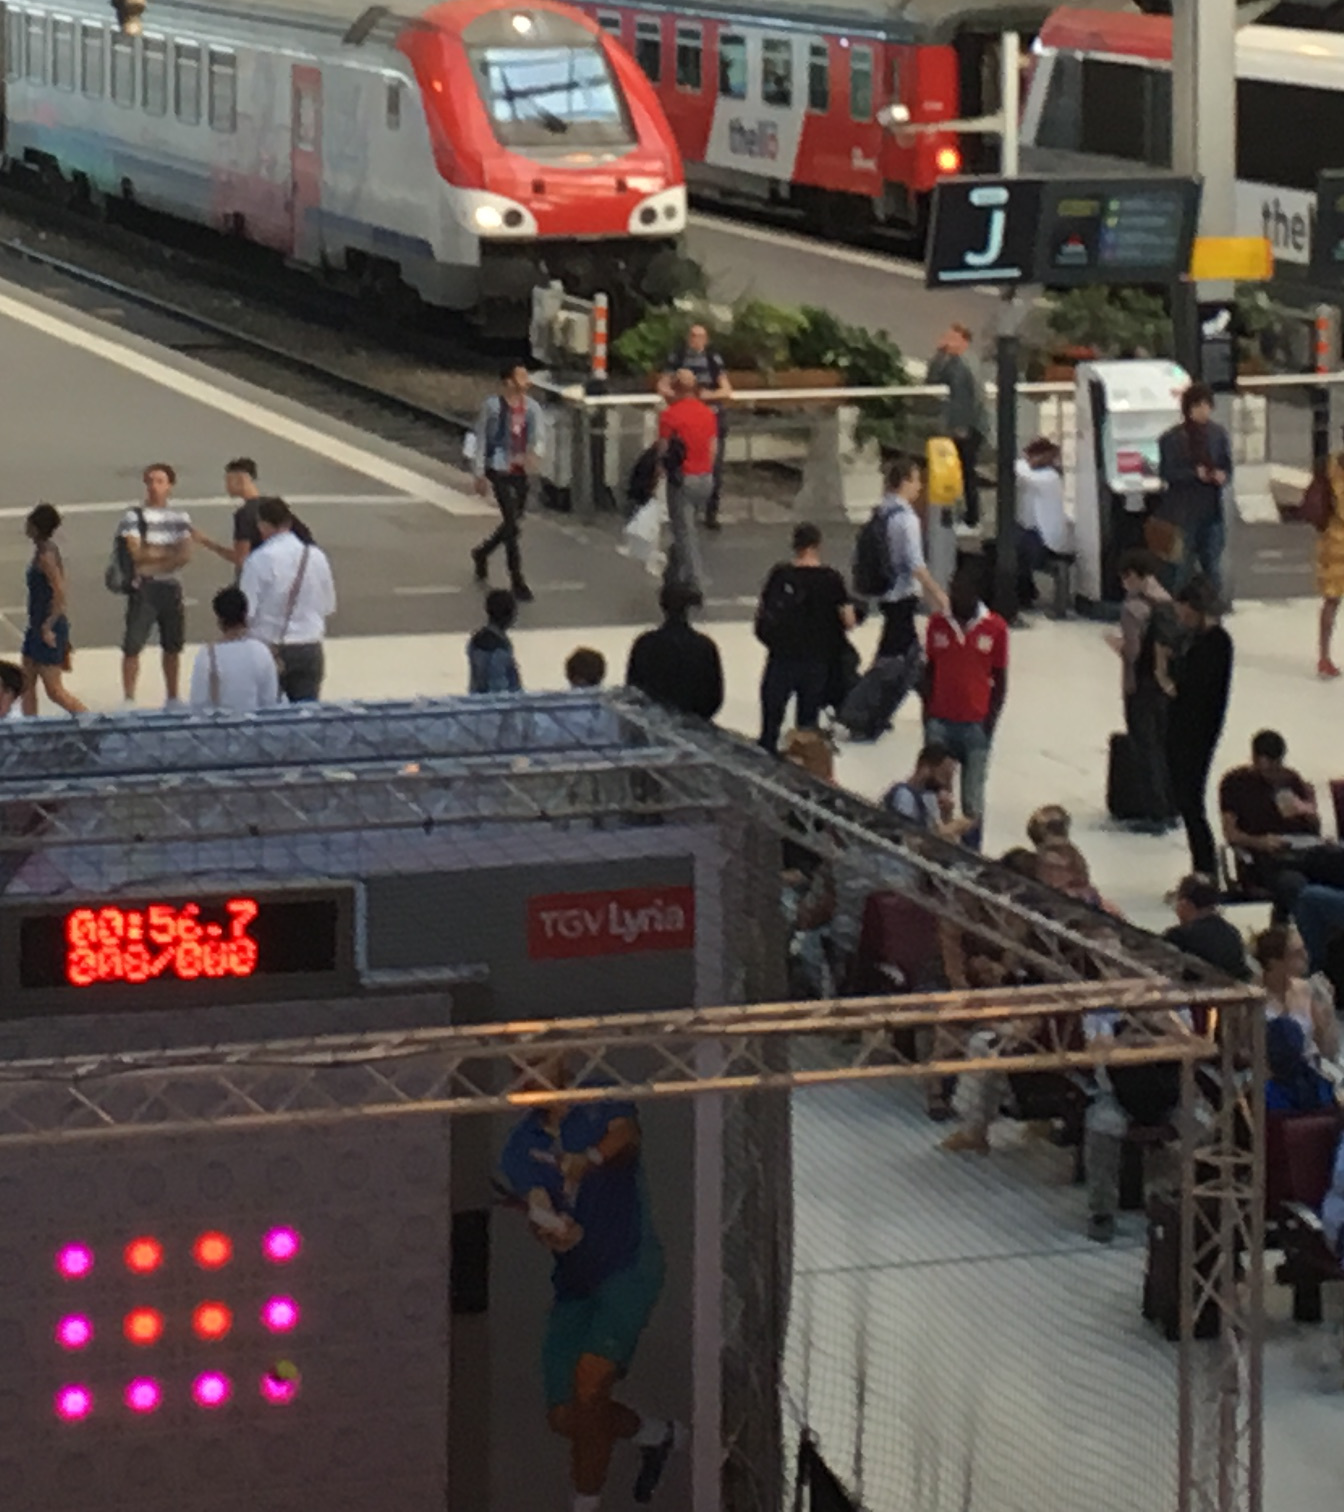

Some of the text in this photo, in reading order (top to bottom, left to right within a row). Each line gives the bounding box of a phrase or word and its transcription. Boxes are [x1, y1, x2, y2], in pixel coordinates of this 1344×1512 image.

[962, 208, 1006, 267] J
[539, 899, 686, 944] TGV Lyria
